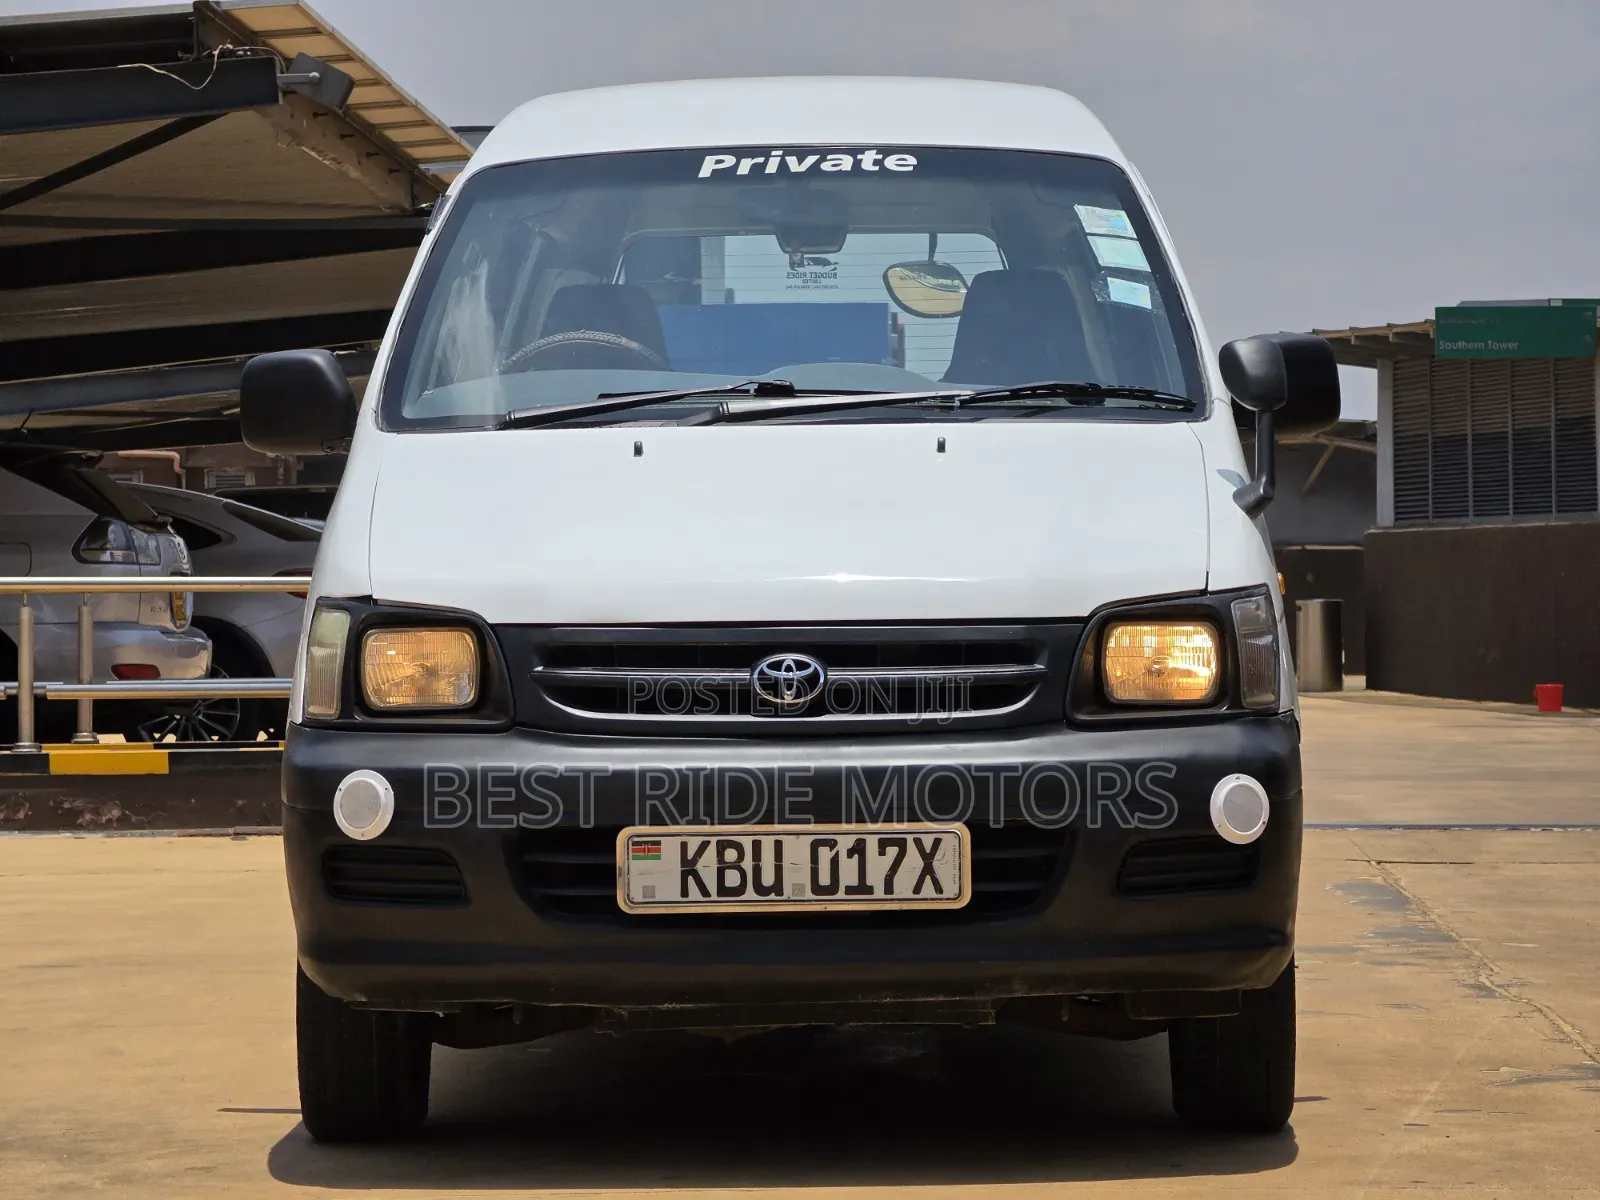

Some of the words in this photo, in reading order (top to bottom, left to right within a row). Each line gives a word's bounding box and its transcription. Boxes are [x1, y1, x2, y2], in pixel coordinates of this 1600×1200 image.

[698, 149, 918, 178] Private
[1439, 340, 1484, 350] Southern
[1488, 340, 1519, 350] Tower
[680, 838, 784, 899] KBU
[809, 837, 944, 897] 017X
